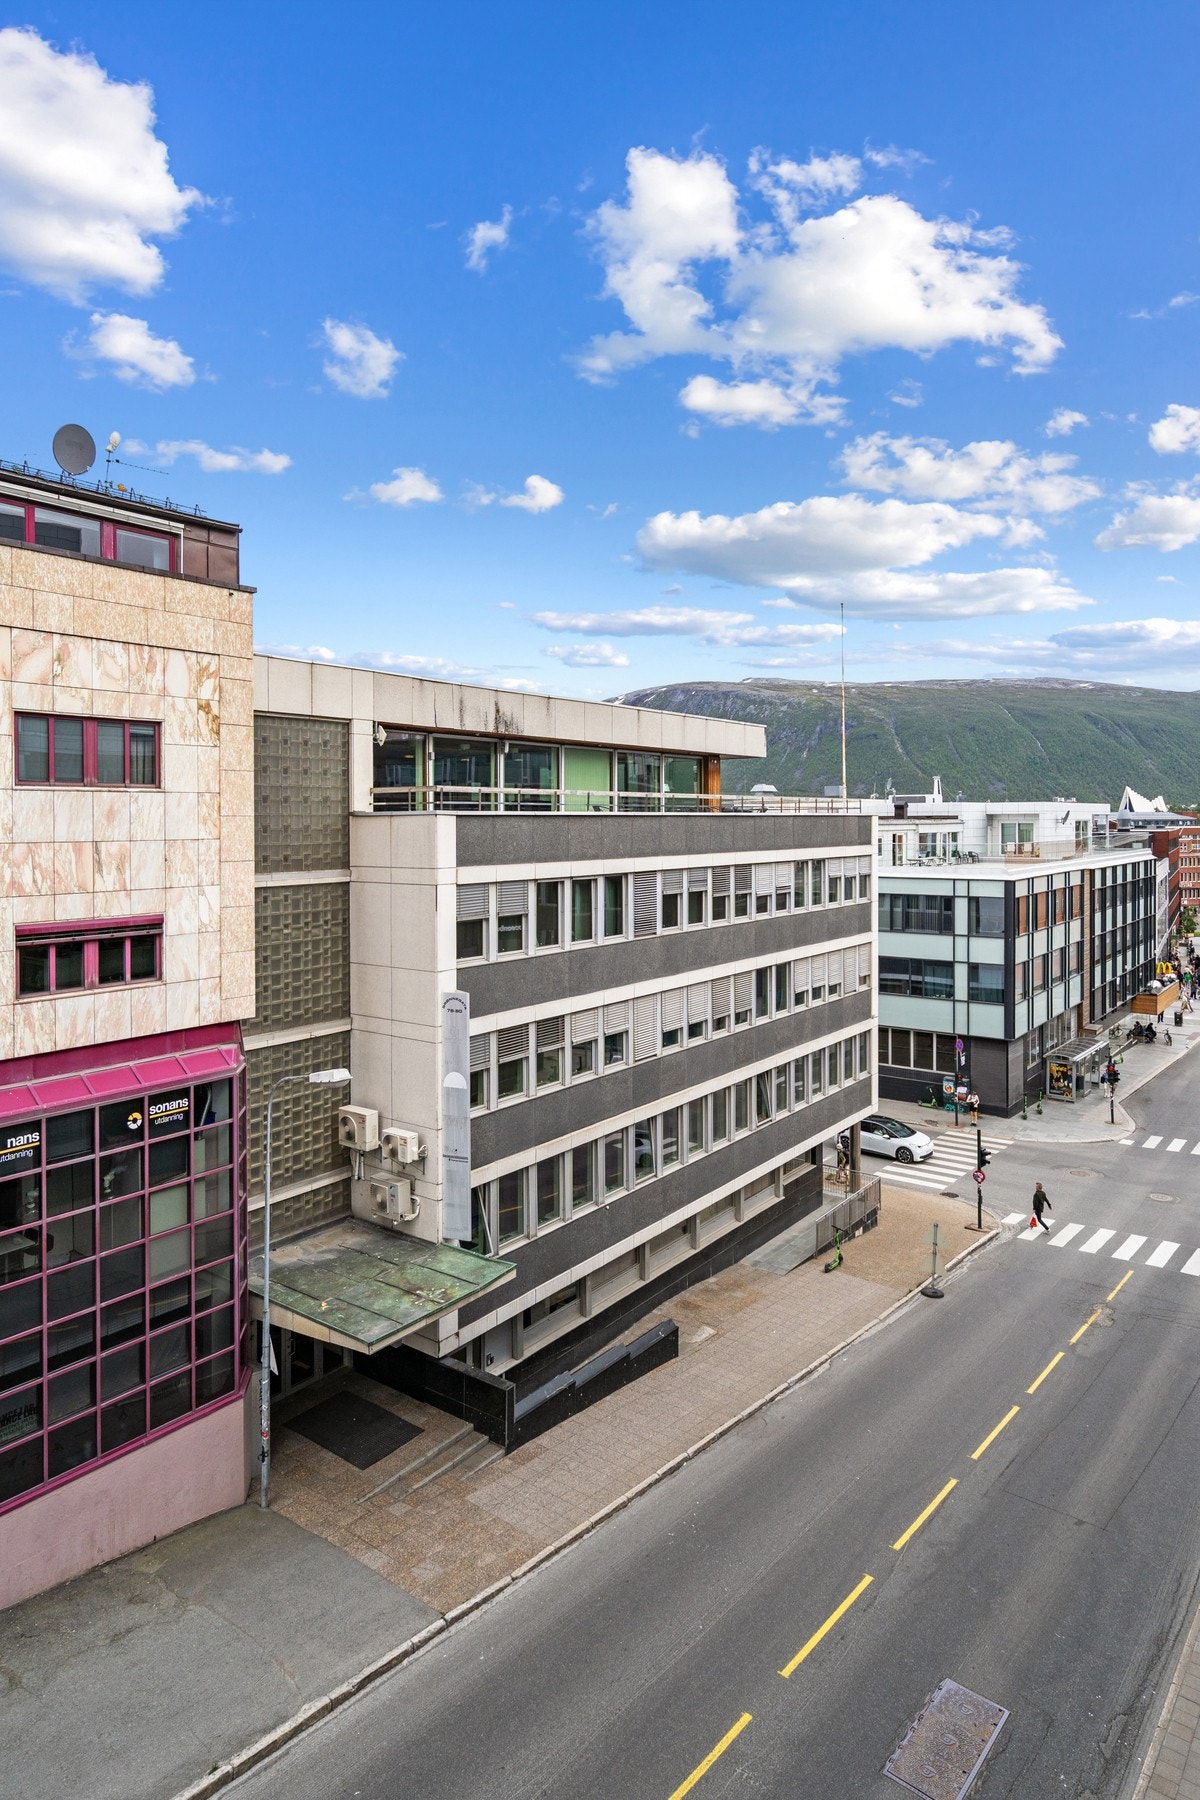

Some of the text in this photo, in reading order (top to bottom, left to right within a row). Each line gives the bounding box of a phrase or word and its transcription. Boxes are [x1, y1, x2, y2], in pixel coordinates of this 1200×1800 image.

[149, 1098, 189, 1115] sonans
[154, 1113, 184, 1125] utdanning
[7, 1131, 40, 1148] nans
